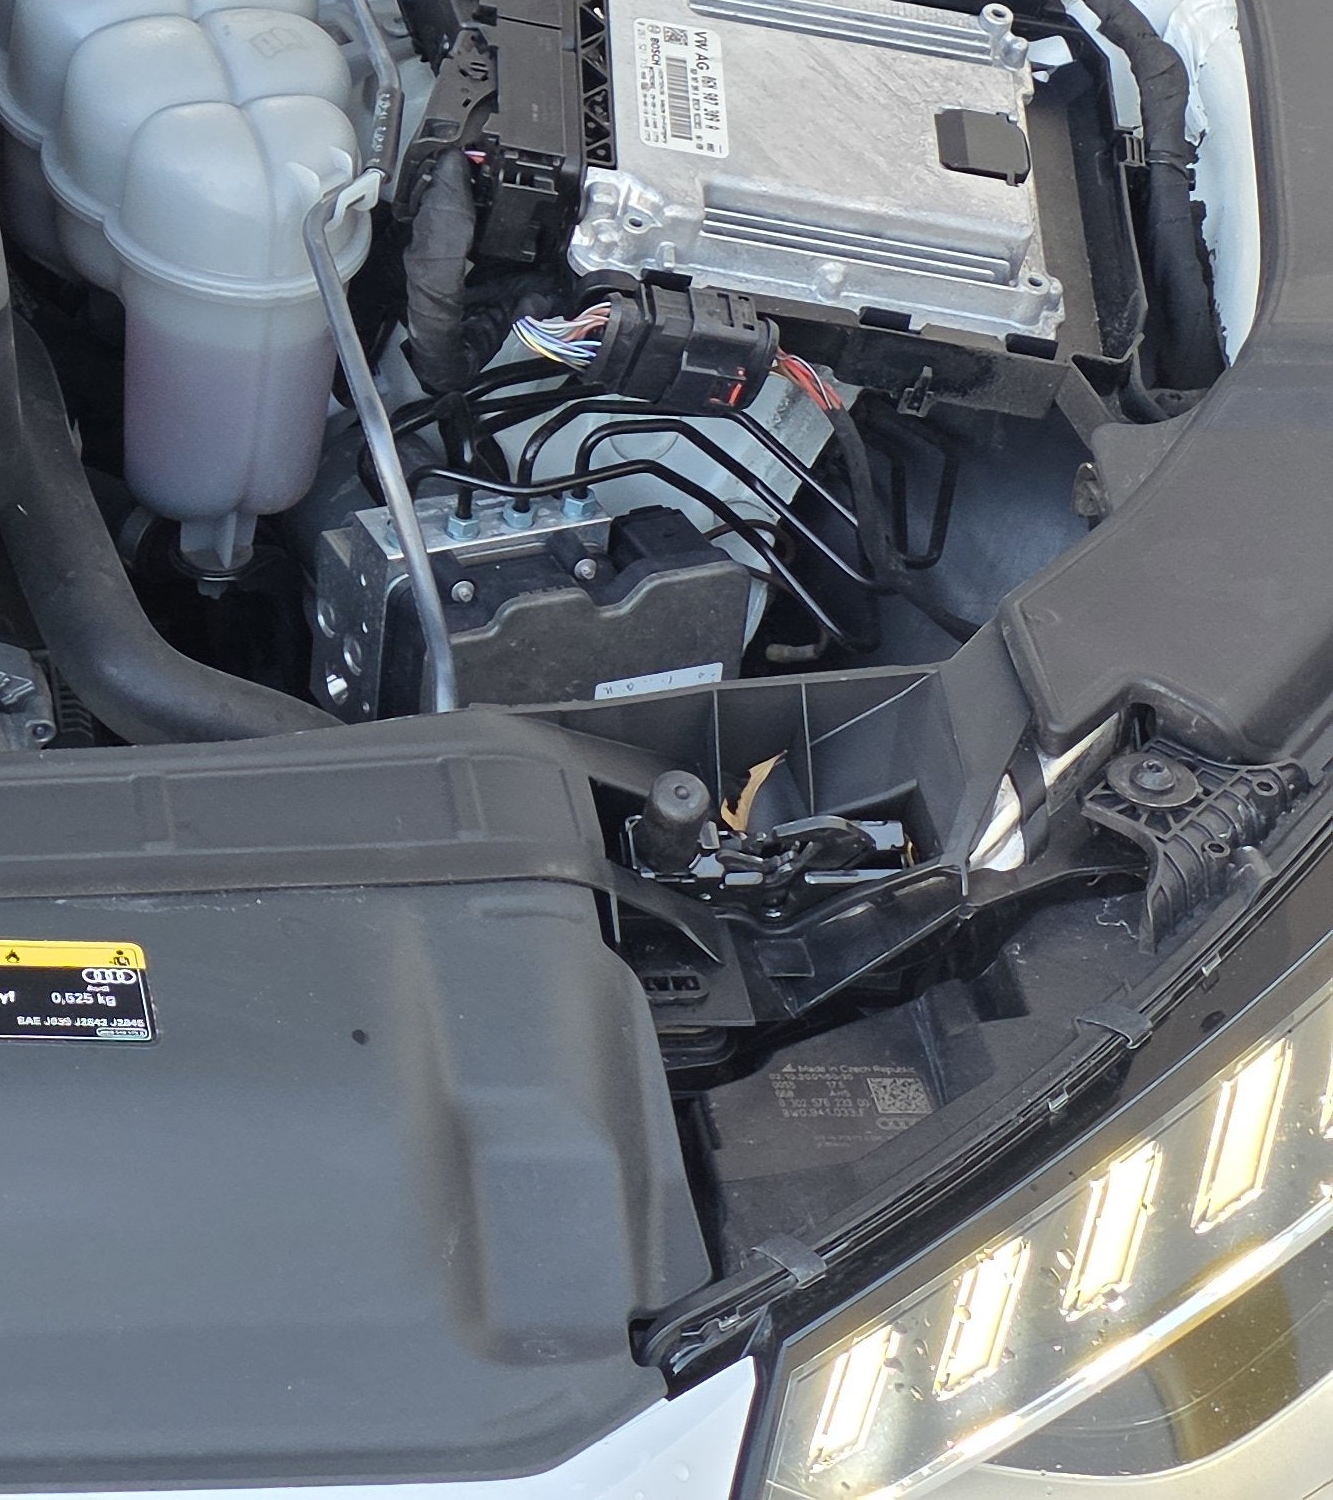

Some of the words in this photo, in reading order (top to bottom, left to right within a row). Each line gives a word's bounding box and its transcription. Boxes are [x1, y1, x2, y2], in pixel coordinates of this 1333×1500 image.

[694, 32, 708, 51] VW
[650, 37, 661, 66] BOSCH
[696, 53, 710, 71] AG
[98, 993, 117, 1007] kg
[17, 1016, 42, 1026] SAE
[798, 1065, 826, 1073] Made
[839, 1064, 871, 1074] Czech
[872, 1064, 916, 1075] Republic
